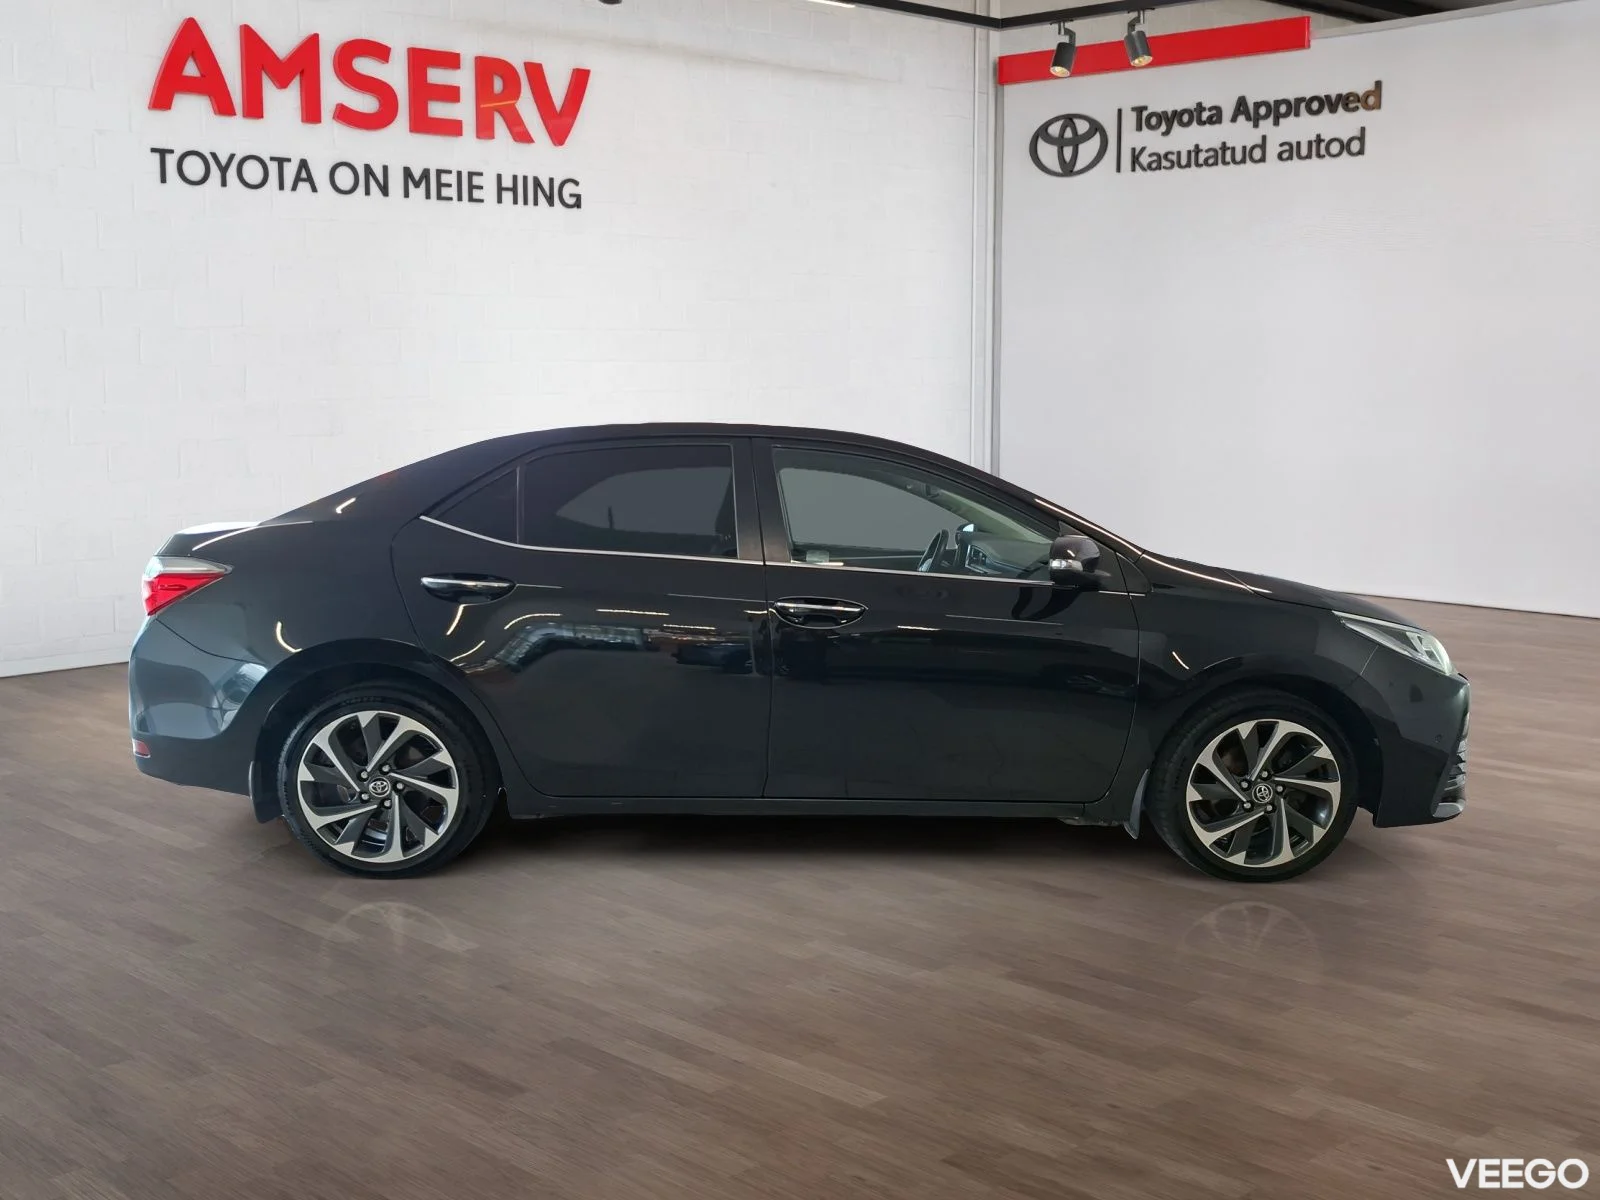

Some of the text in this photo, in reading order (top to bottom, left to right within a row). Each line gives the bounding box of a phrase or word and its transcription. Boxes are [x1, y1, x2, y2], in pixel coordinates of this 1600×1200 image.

[148, 17, 591, 147] AMSERV
[1130, 80, 1382, 137] Toyota Approved
[150, 147, 582, 209] TOYOTA ON MEIE HING
[1130, 126, 1366, 172] Kasutatud autod
